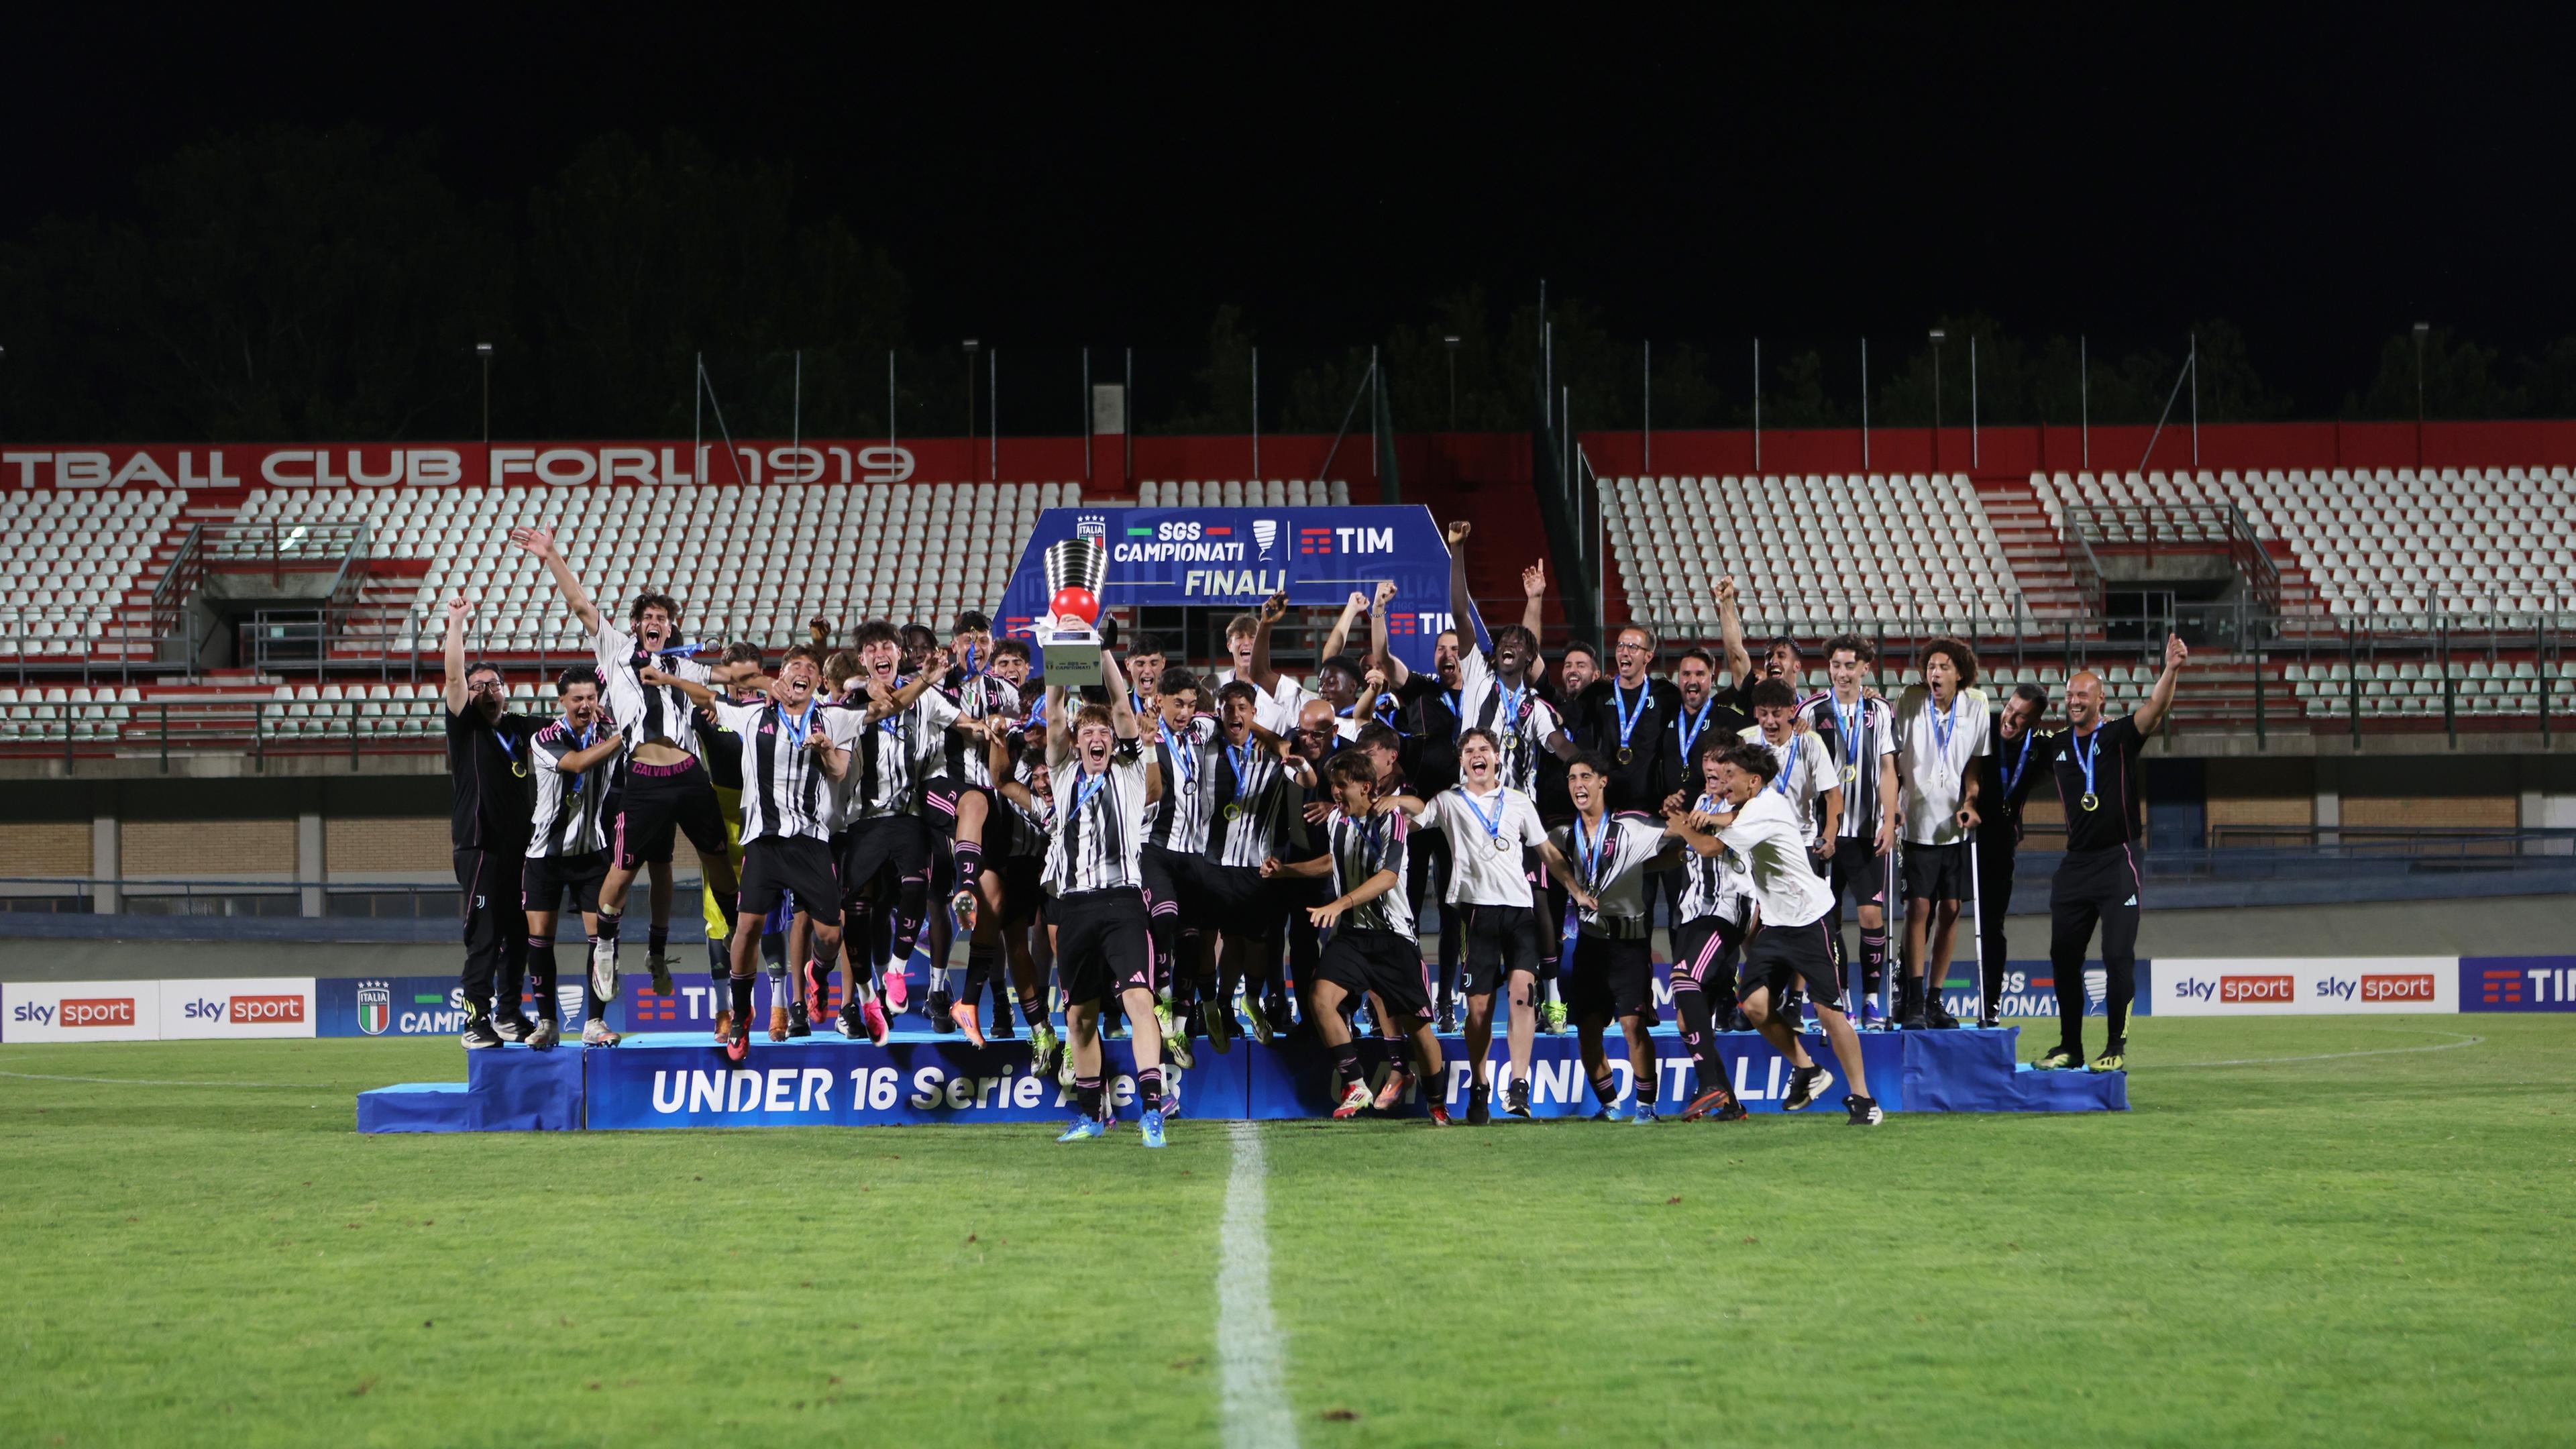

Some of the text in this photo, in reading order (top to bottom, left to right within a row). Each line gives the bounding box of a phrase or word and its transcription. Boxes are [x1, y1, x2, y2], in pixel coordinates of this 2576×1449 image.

[3, 451, 241, 488] TBALL
[261, 449, 462, 487] CLUB
[739, 446, 915, 484] 1919
[1079, 525, 1102, 534] ITALIA
[1158, 522, 1201, 541] SGS
[1336, 527, 1393, 553] TIM
[1114, 543, 1244, 562] CAMPIONATI
[1185, 570, 1286, 596] FINALI
[633, 755, 695, 777] CALVIN KLEIN
[360, 994, 387, 1003] ITALIA
[2176, 977, 2289, 1002] sky sport
[2316, 977, 2430, 1001] sky sport
[15, 1002, 129, 1026] sky sport
[185, 998, 299, 1022] sky sport
[653, 1069, 833, 1114] UNDER
[850, 1067, 898, 1110] 16
[911, 1064, 1042, 1110] Serie
[1109, 1075, 1136, 1107] e
